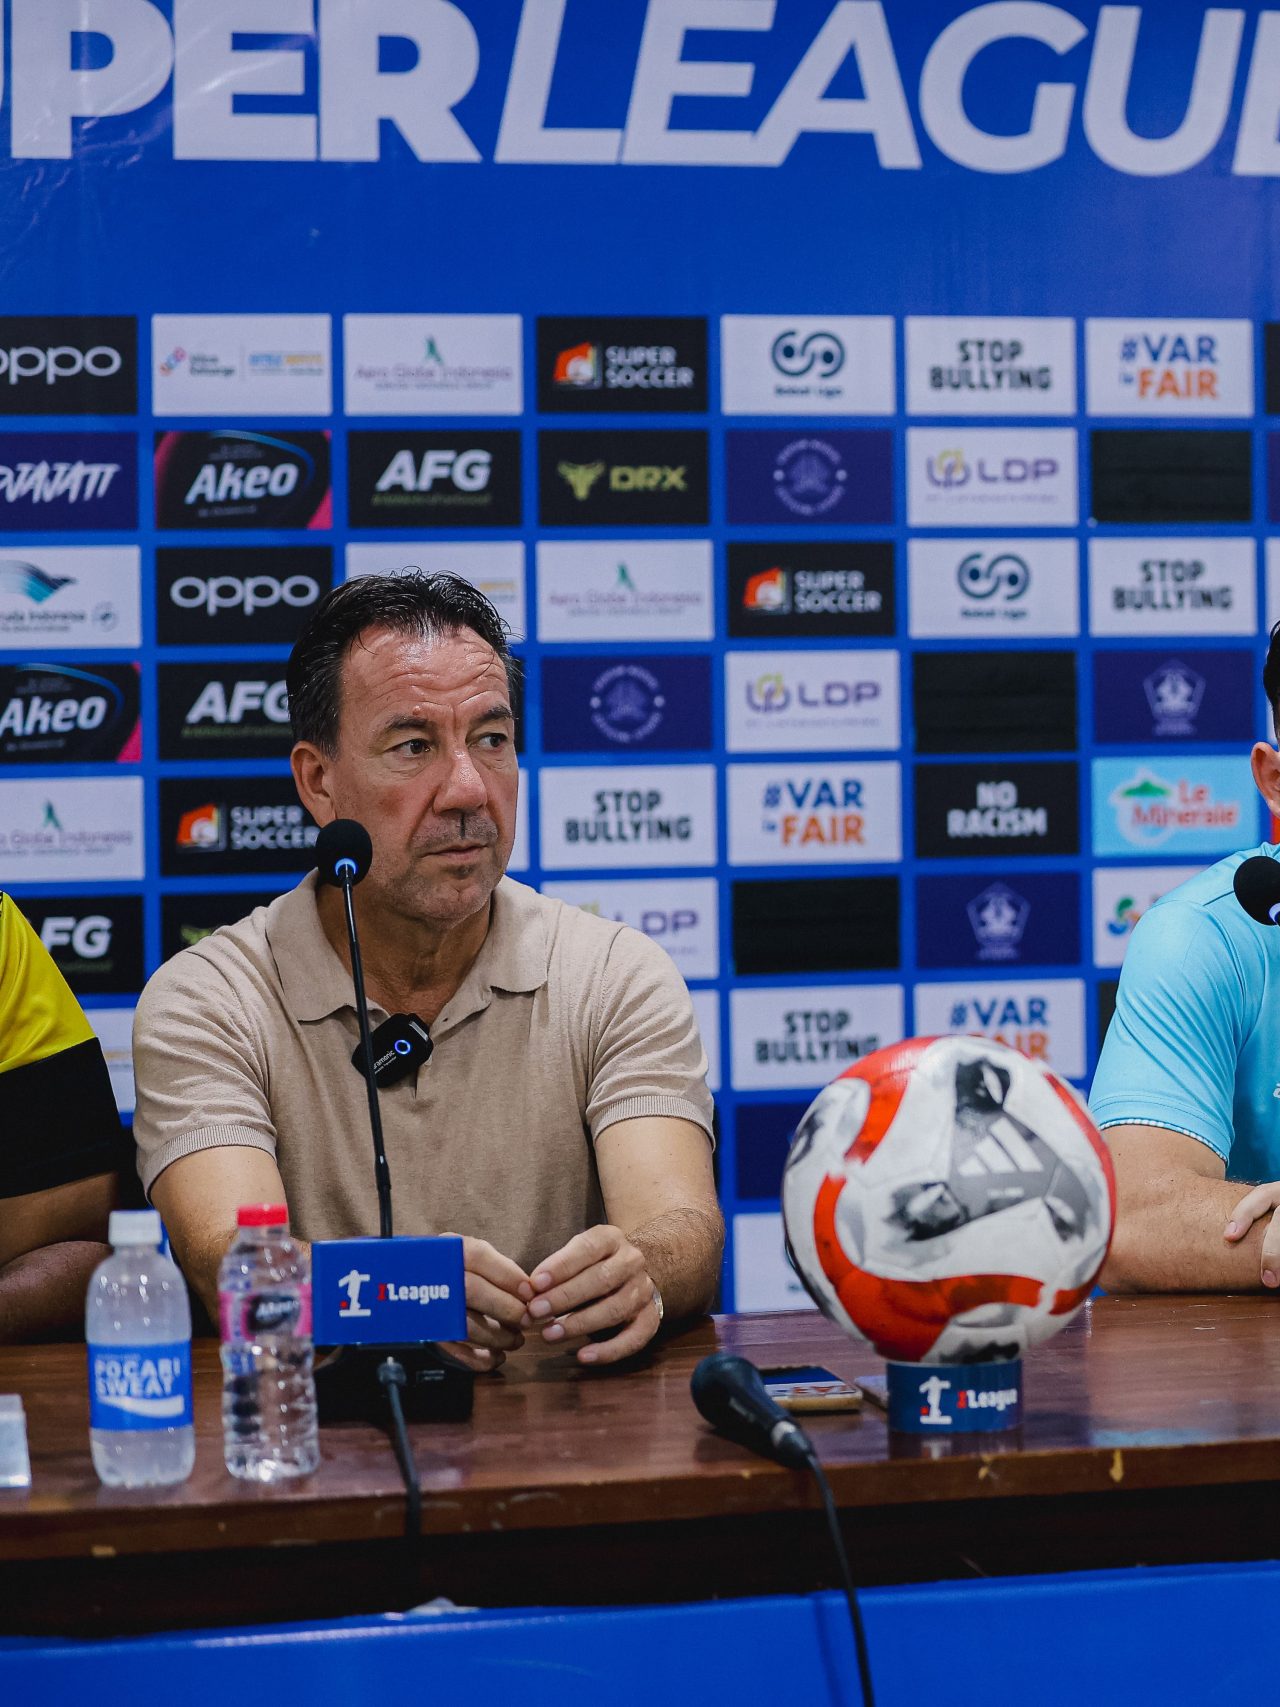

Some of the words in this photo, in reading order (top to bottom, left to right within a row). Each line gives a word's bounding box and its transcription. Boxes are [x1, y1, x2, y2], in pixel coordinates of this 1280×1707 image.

[605, 346, 676, 366] SUPER
[957, 340, 1023, 363] STOP
[1120, 335, 1218, 364] #VAR
[605, 366, 694, 388] SOCCER
[930, 366, 1052, 391] BULLYING
[1138, 367, 1218, 399] FAIR
[184, 462, 299, 505] Akeo
[375, 449, 492, 492] AFG
[610, 465, 687, 491] DRX
[977, 458, 1060, 484] LDP
[794, 570, 866, 591] SUPER
[1140, 559, 1205, 583] STOP
[171, 575, 320, 616] oppo
[794, 590, 883, 613] SOCCER
[1112, 586, 1234, 611] BULLYING
[186, 680, 291, 724] AFG
[798, 681, 881, 708] LDP
[0, 694, 108, 738] Akeo
[596, 790, 662, 814] STOP
[763, 779, 865, 808] #VAR
[976, 780, 1018, 808] NO
[1178, 778, 1209, 803] Le
[231, 805, 302, 824] SUPER
[948, 807, 1047, 838] RACISM
[231, 827, 317, 850] SOCCER
[565, 816, 692, 843] BULLYING
[781, 814, 866, 847] FAIR
[615, 910, 699, 936] DP
[28, 914, 113, 959] FG
[784, 1009, 851, 1034] STOP
[950, 997, 1049, 1028] #VAR
[95, 1358, 181, 1378] POCARI
